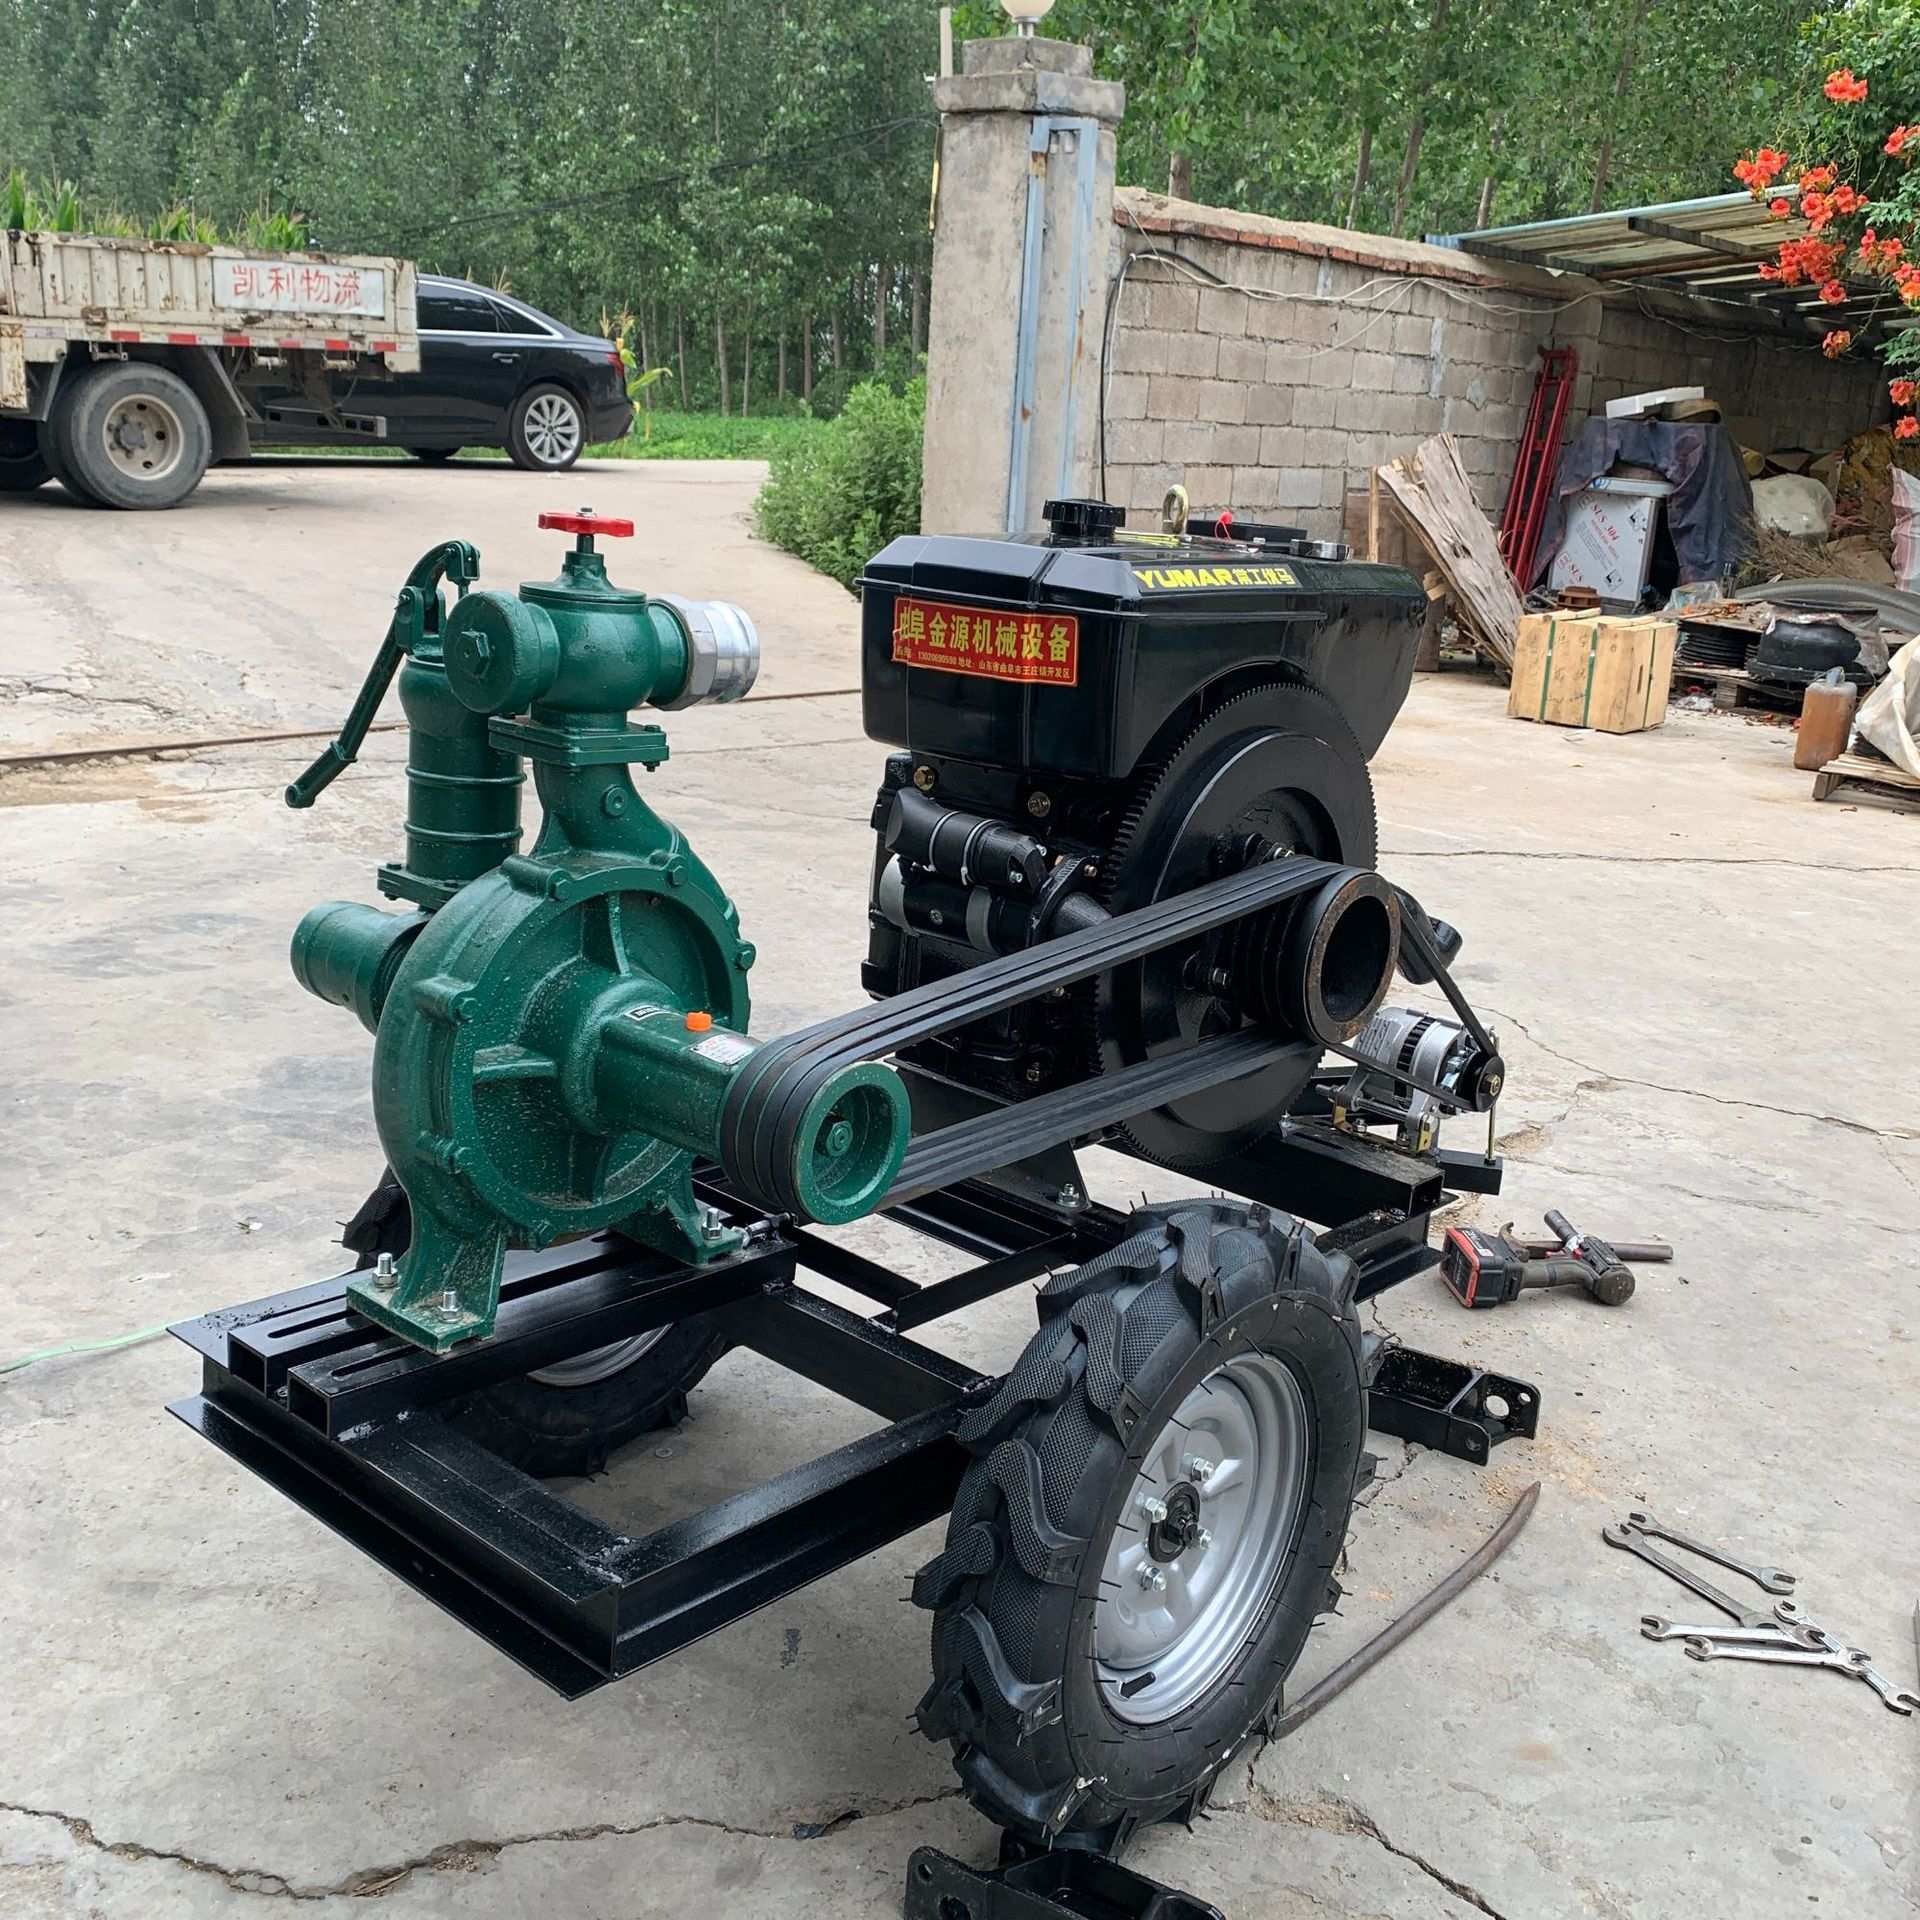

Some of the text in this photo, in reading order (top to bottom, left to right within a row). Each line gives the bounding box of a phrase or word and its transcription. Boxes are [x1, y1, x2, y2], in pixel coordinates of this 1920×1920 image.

[232, 263, 361, 306] 凯利物流
[1132, 568, 1238, 588] YUMAR
